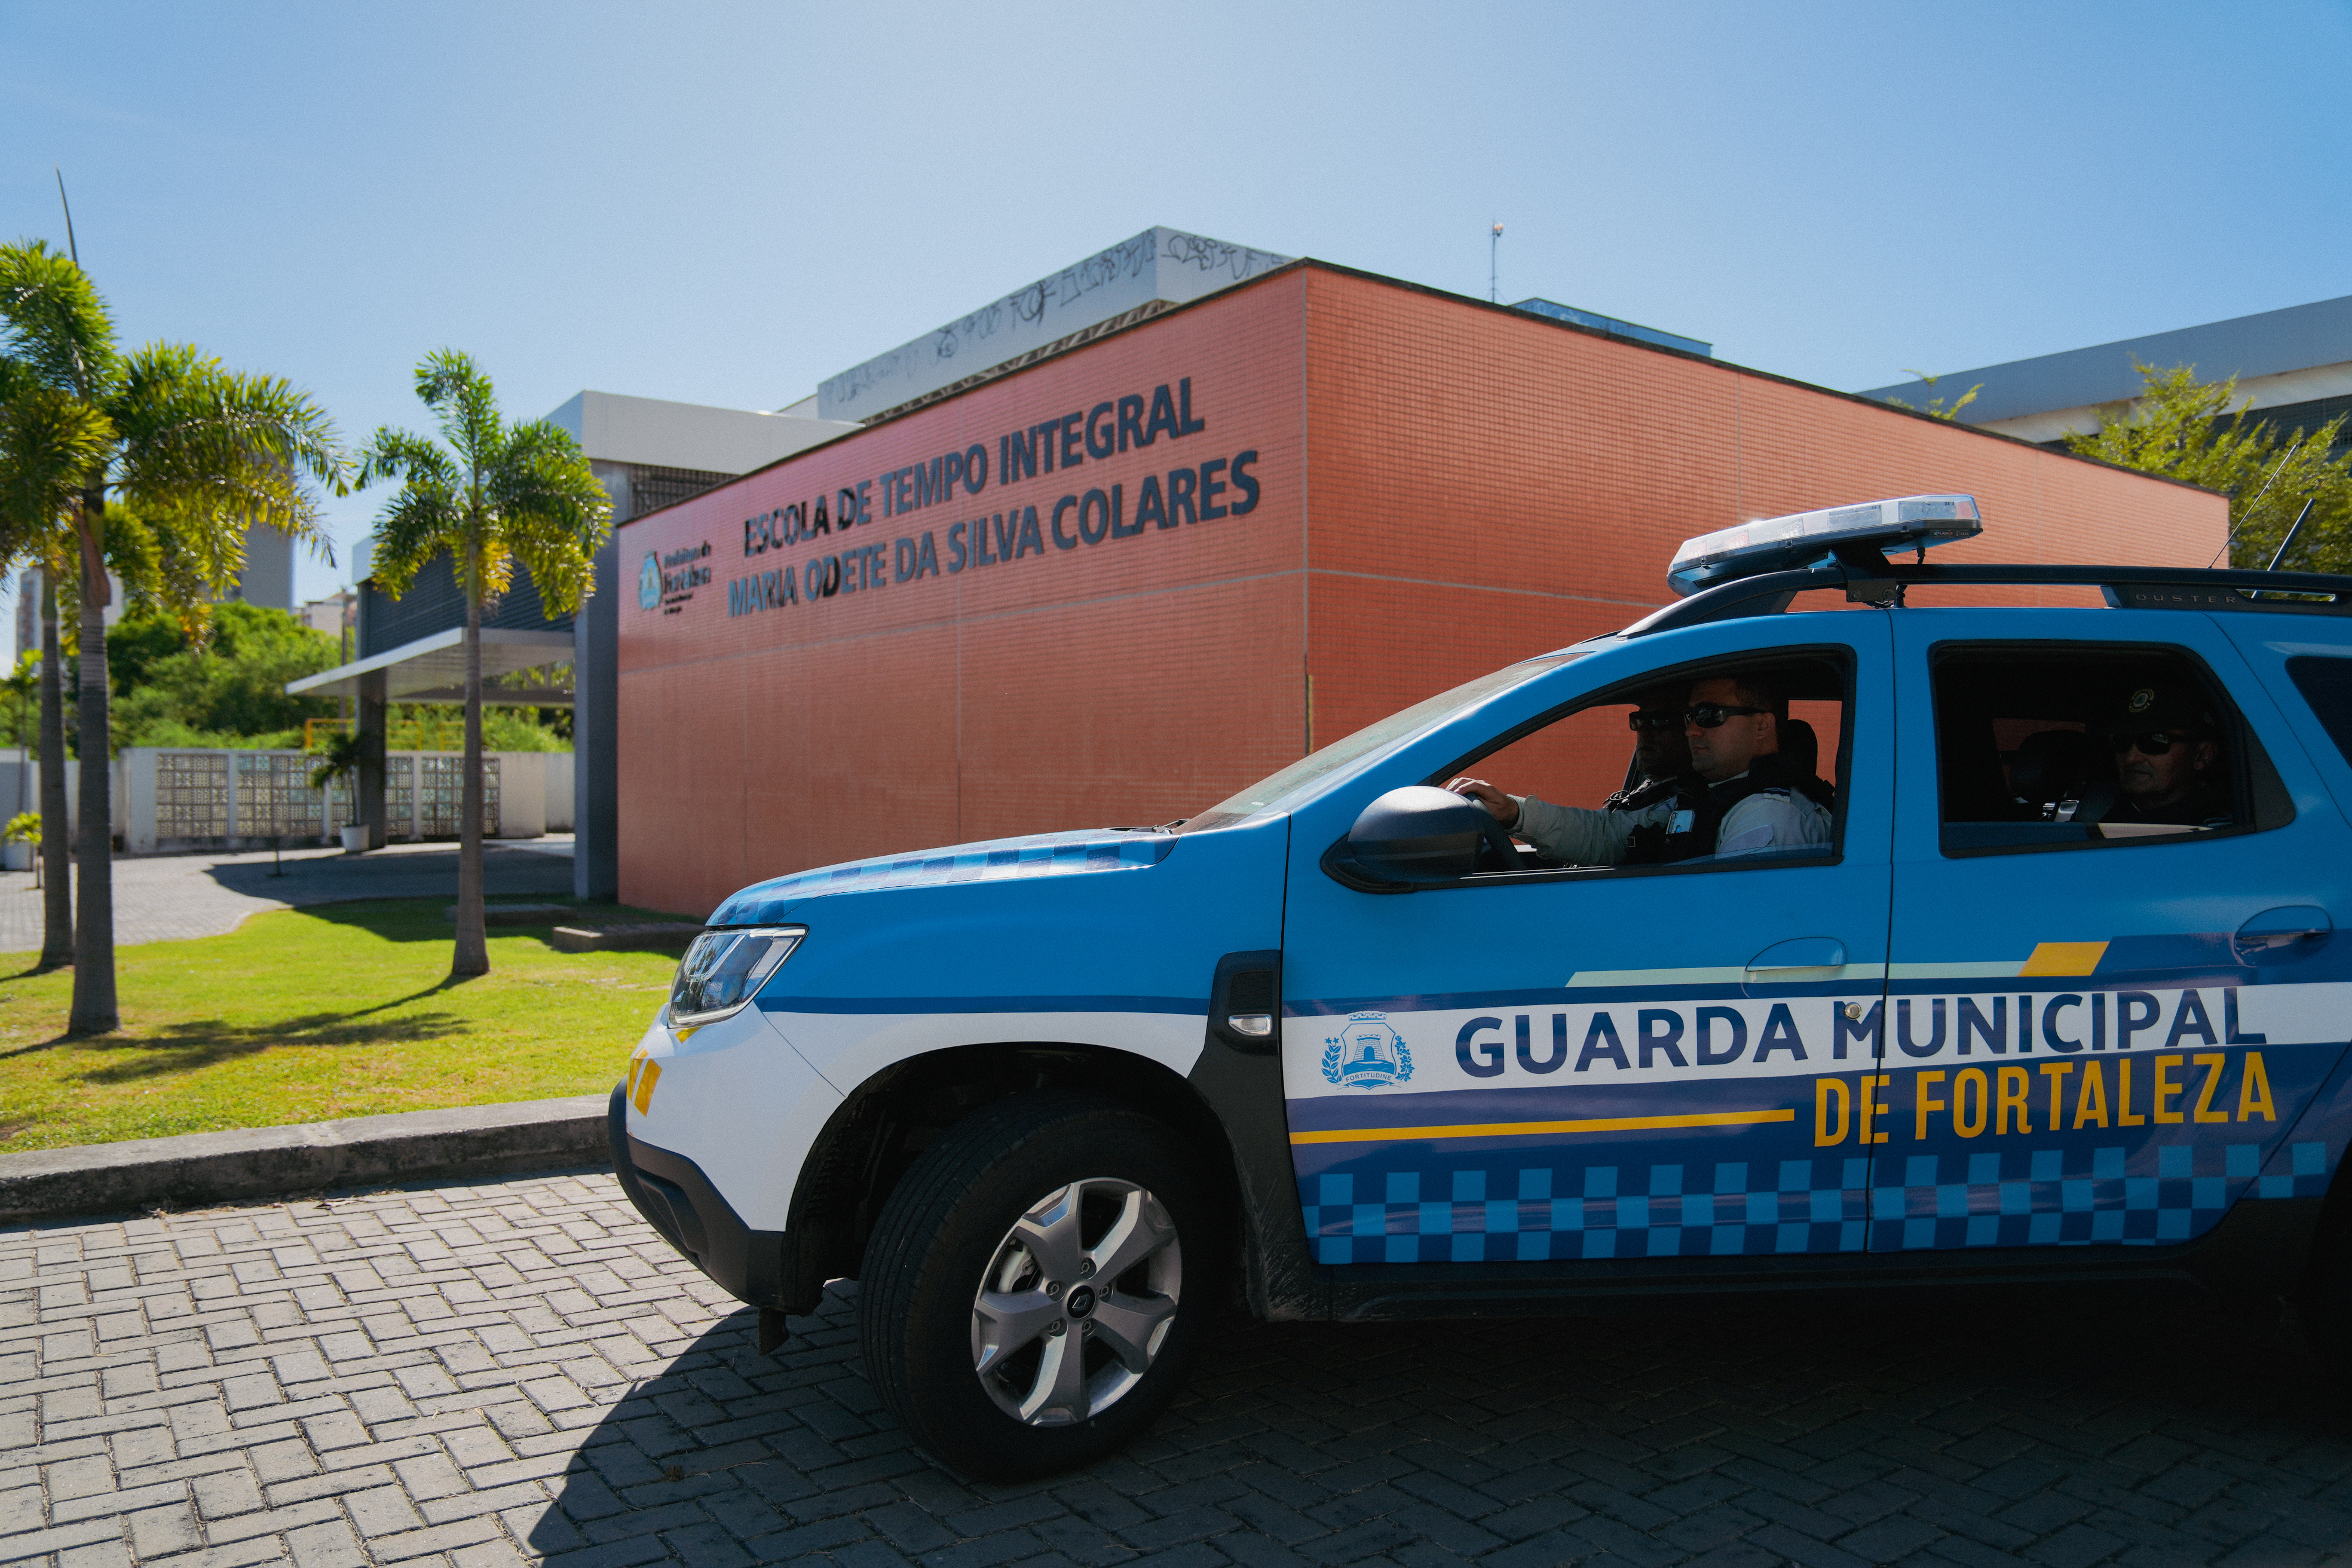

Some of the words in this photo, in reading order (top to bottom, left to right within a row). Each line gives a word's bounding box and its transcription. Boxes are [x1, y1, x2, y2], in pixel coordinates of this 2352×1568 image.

[745, 494, 831, 558] ESCOLA
[837, 480, 871, 531] DE
[879, 443, 988, 518] TEMPO
[1000, 376, 1205, 486] INTEGRAL
[727, 565, 798, 618] MARIA
[804, 543, 886, 601] ODETE
[895, 531, 939, 584] DA
[947, 504, 1045, 574] SILVA
[1051, 449, 1260, 550] COLARES
[2135, 593, 2236, 604] DUSTER
[1346, 1073, 1392, 1082] FORTITUDINE
[1454, 1003, 1809, 1078] GUARDA
[1832, 987, 2268, 1060] MUNICIPAL
[1814, 1074, 1889, 1147] DE
[1914, 1051, 2277, 1140] FORTALEZA
